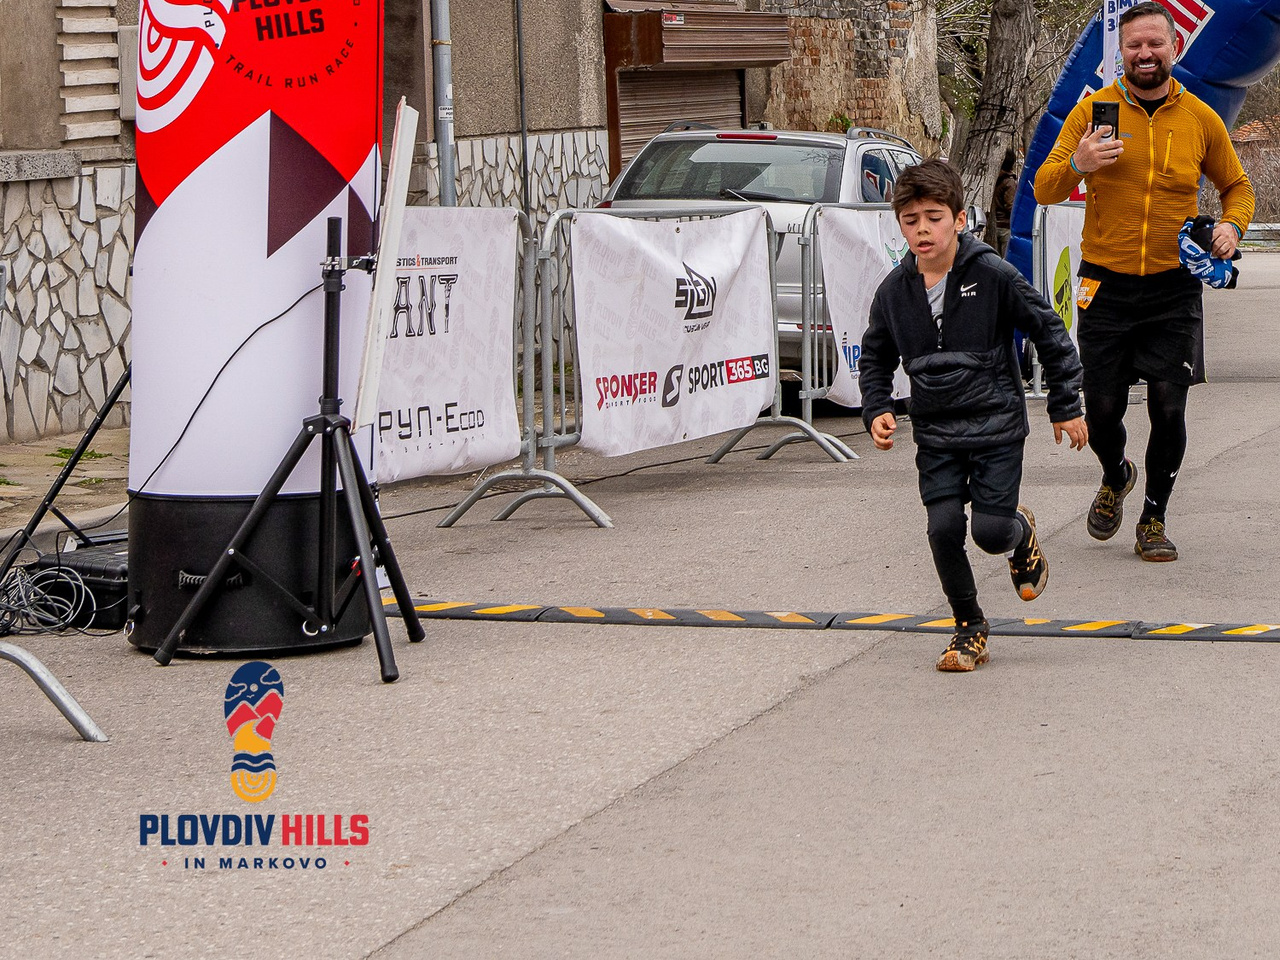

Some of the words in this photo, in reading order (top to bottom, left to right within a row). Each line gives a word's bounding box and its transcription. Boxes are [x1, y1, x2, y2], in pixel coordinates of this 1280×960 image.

[255, 8, 326, 41] HILLS
[225, 54, 273, 87] TRAIL
[284, 72, 319, 89] RUN
[325, 39, 354, 75] RACE
[396, 257, 416, 267] STICS
[421, 256, 458, 266] TRANSPORT
[389, 274, 459, 339] ANT
[596, 371, 658, 411] SPONSER
